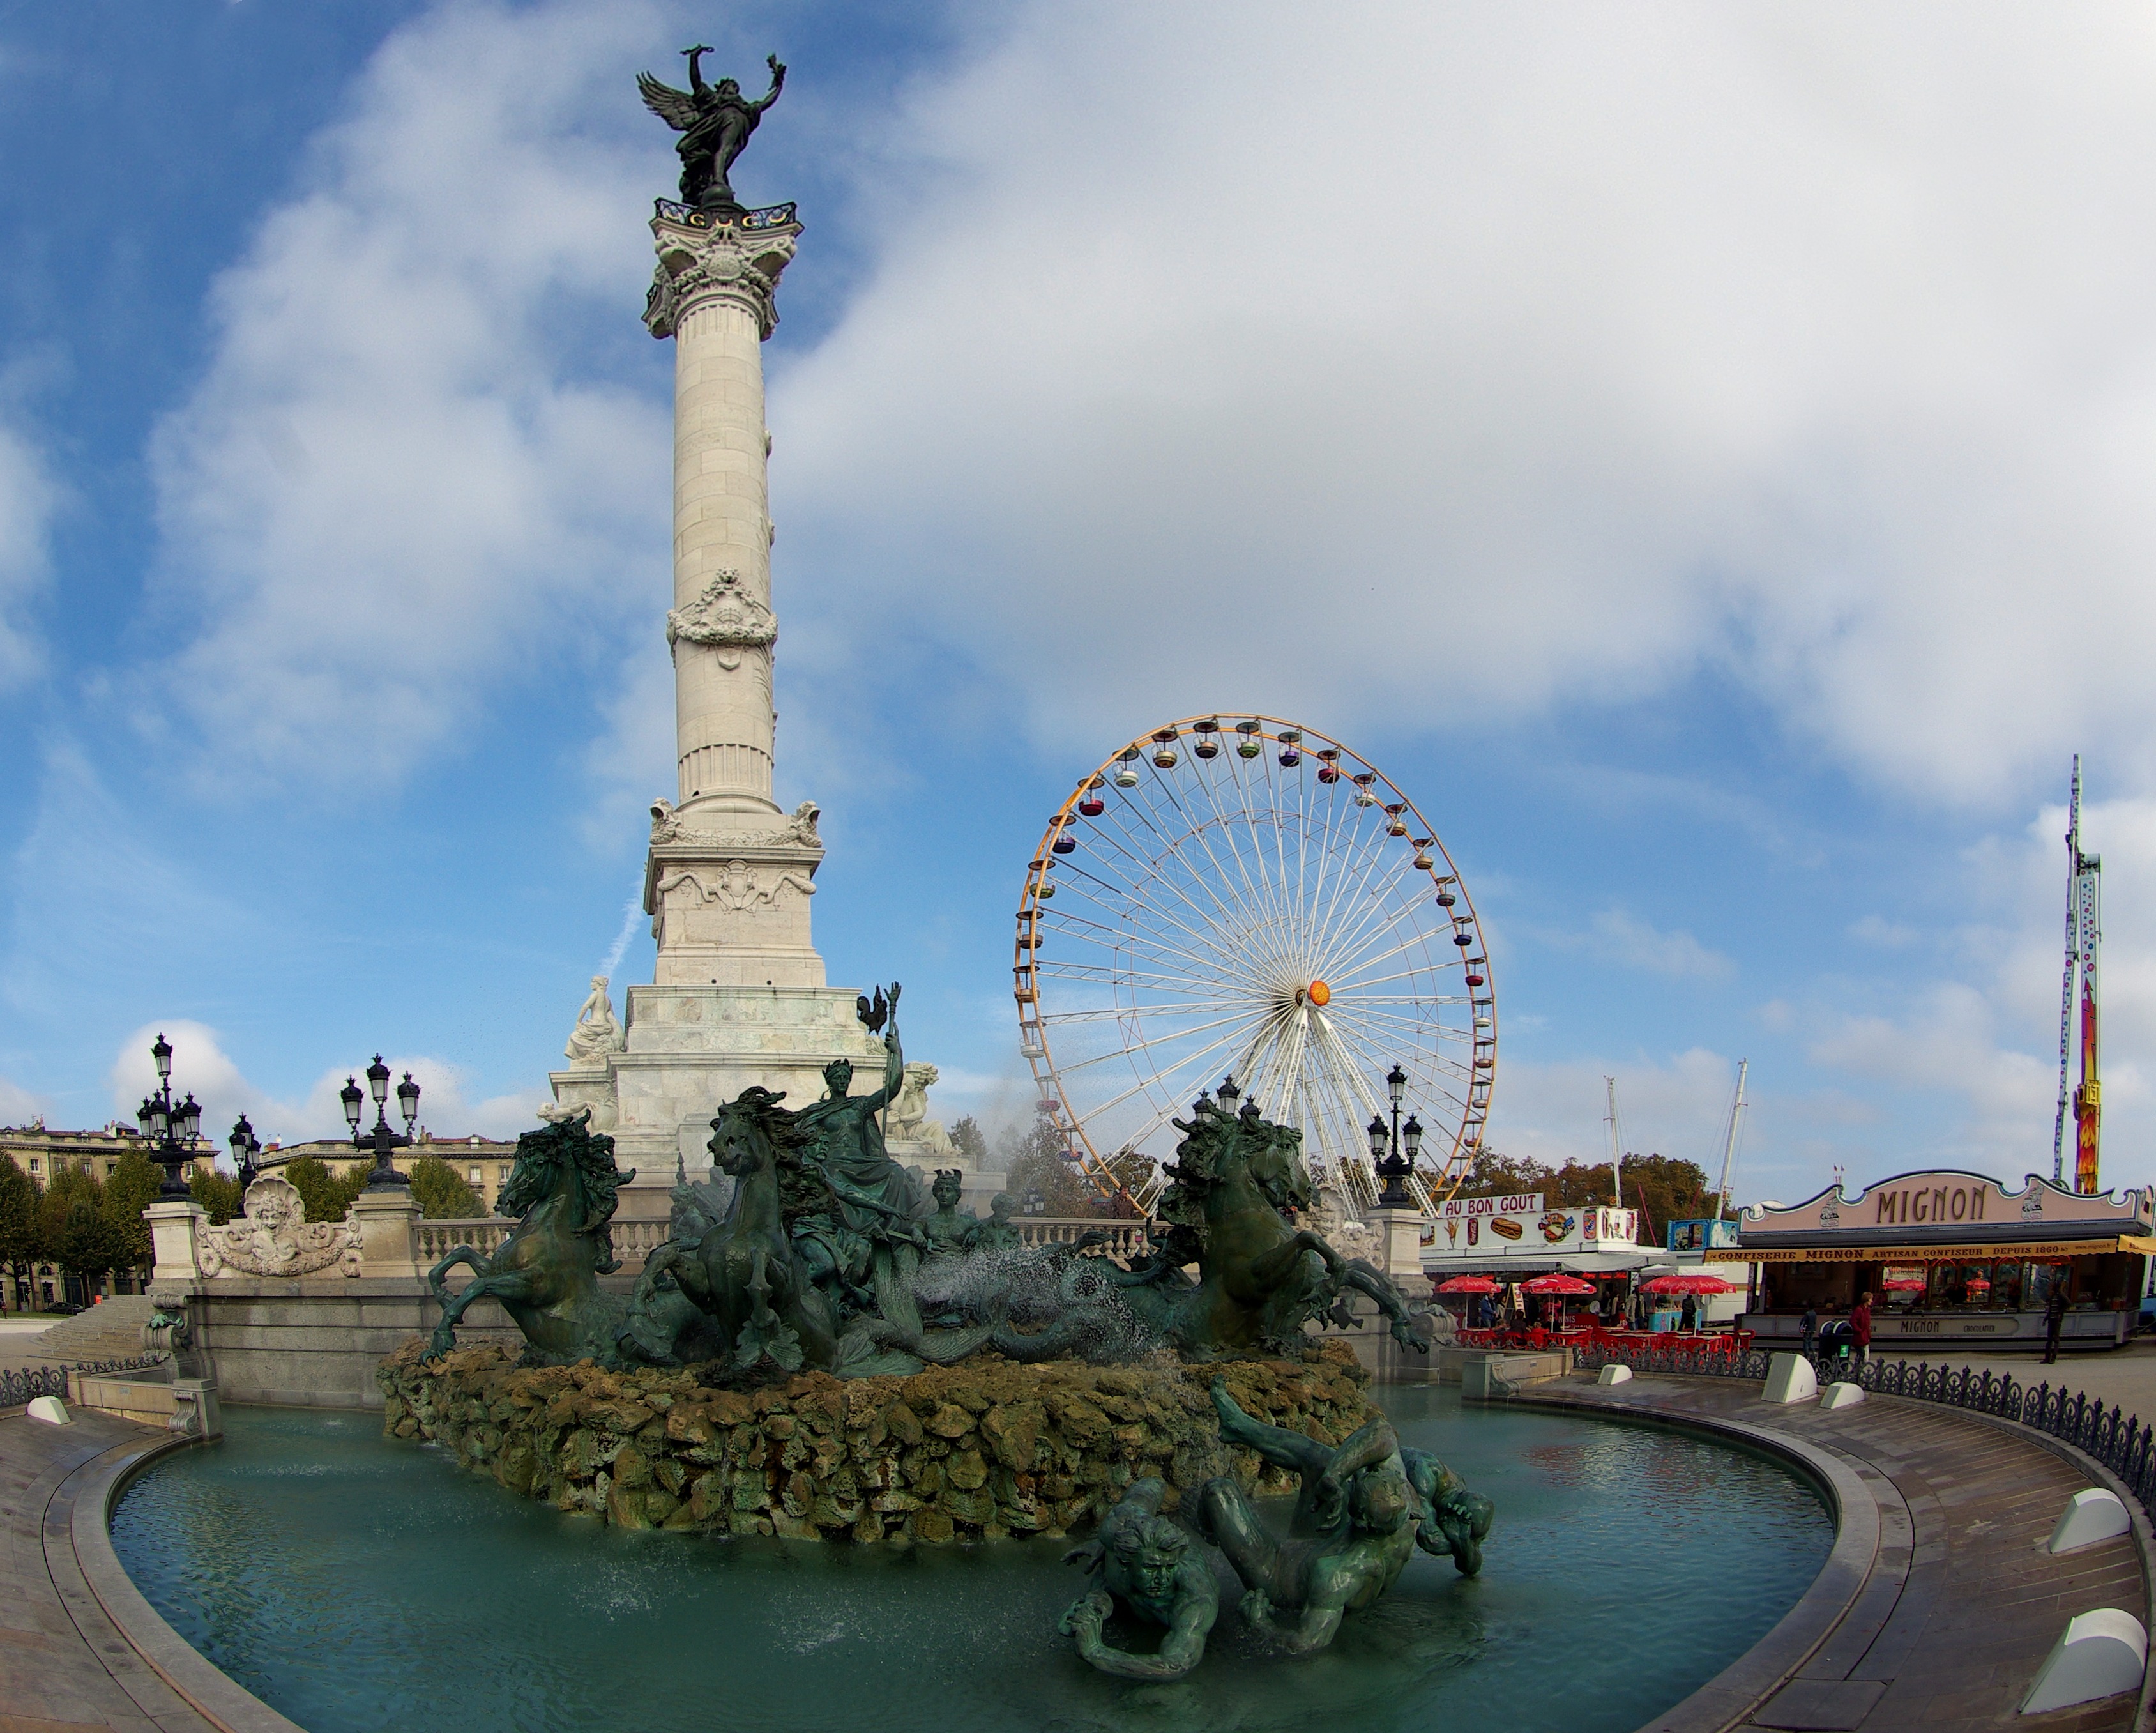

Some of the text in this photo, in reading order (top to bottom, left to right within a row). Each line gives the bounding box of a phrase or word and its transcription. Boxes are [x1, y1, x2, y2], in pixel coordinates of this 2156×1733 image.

[1446, 1195, 1536, 1216] AU BON GOUT
[1876, 1184, 1987, 1223] MIGNON
[1718, 1251, 1796, 1260] CONFISERIE
[1805, 1249, 1864, 1259] MIGNON
[2036, 1246, 2058, 1254] 1860
[1901, 1320, 1939, 1332] MIGNON
